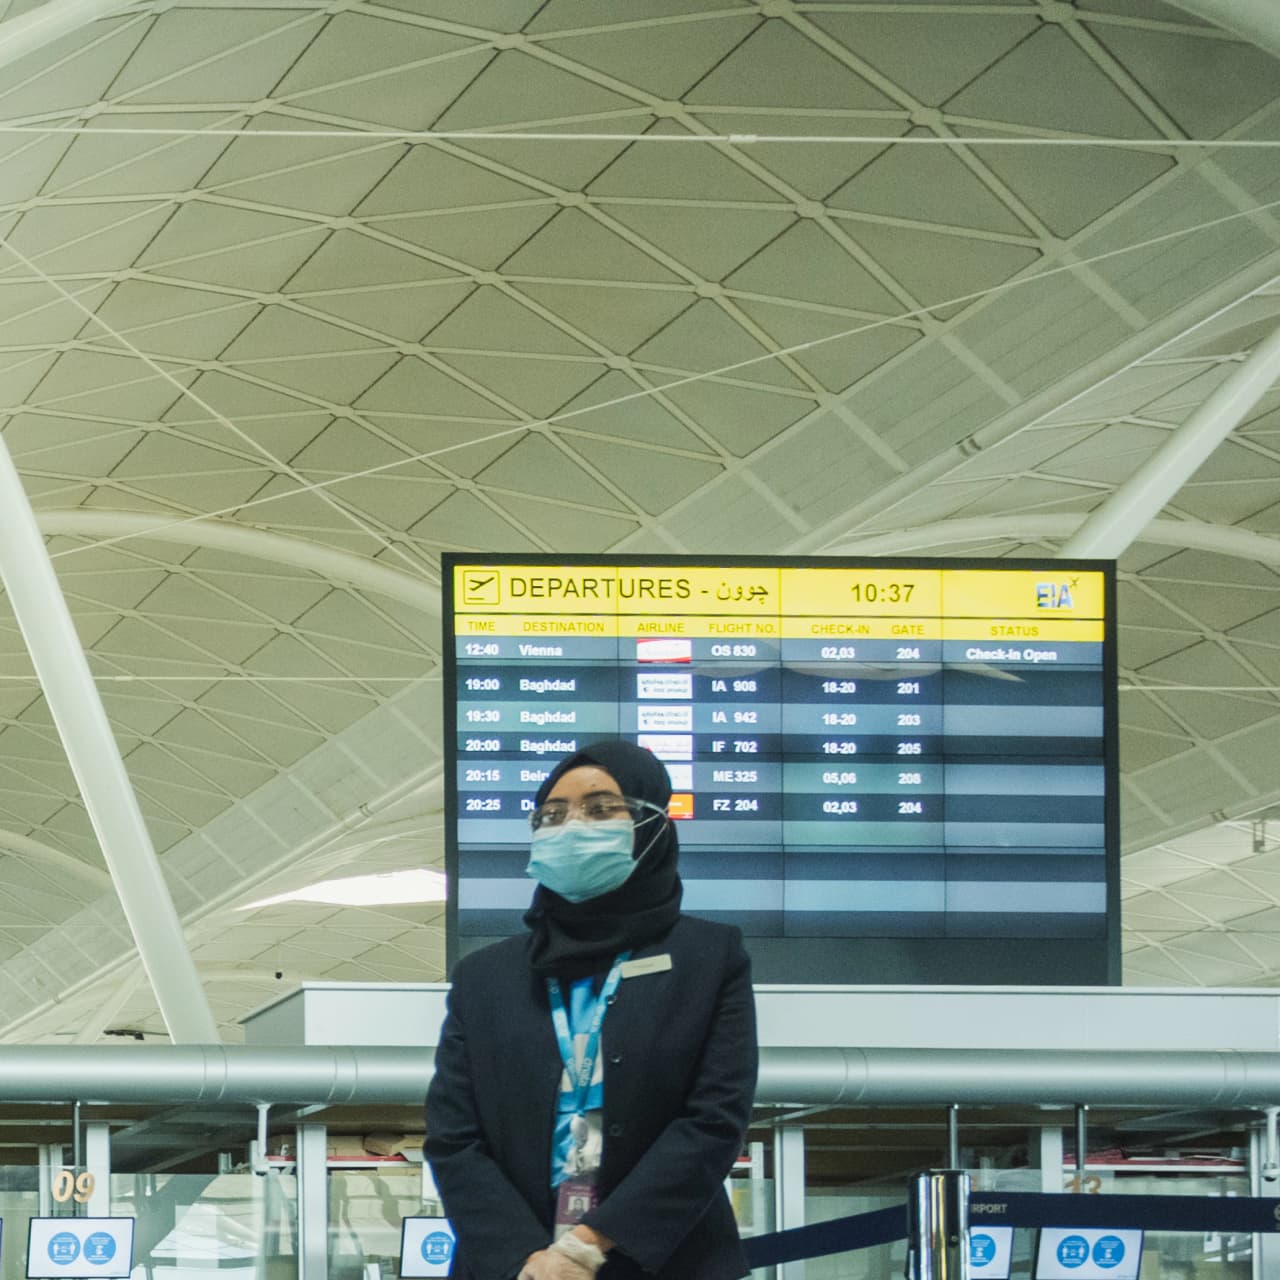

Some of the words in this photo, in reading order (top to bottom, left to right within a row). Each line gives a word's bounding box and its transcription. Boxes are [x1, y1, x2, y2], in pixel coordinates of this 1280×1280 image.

[510, 577, 691, 599] DEPARTURES
[851, 583, 915, 603] 10:37
[468, 621, 496, 633] TIME
[523, 622, 605, 633] DESTINATION
[637, 622, 686, 634] AIRLINE
[708, 623, 752, 634] FLIGHT
[755, 623, 777, 635] NO.
[811, 624, 870, 635] CHECK-IN
[892, 624, 925, 635] GATE
[991, 626, 1039, 637] STATUS
[465, 644, 500, 656] 12:40
[519, 644, 563, 657] Vienna
[711, 645, 731, 657] OS
[896, 648, 920, 660] 204
[965, 648, 1021, 661] Check-in
[1023, 649, 1057, 663] Open
[465, 679, 500, 691] 19:00
[519, 679, 576, 693] Baghdad
[711, 680, 727, 692] IA
[896, 682, 920, 694] 201
[465, 711, 500, 722] 19:30
[520, 711, 576, 724] Baghdad
[712, 712, 728, 724] IA
[465, 740, 500, 752] 20:00
[520, 740, 576, 754] Baghdad
[712, 741, 725, 753] IF
[734, 741, 757, 753] 702
[897, 743, 921, 755] 205
[465, 770, 500, 782] 20:15
[466, 799, 501, 811] 20:25
[713, 800, 731, 811] FZ
[734, 800, 758, 812] 204
[898, 802, 922, 814] 204
[53, 1170, 96, 1203] 09
